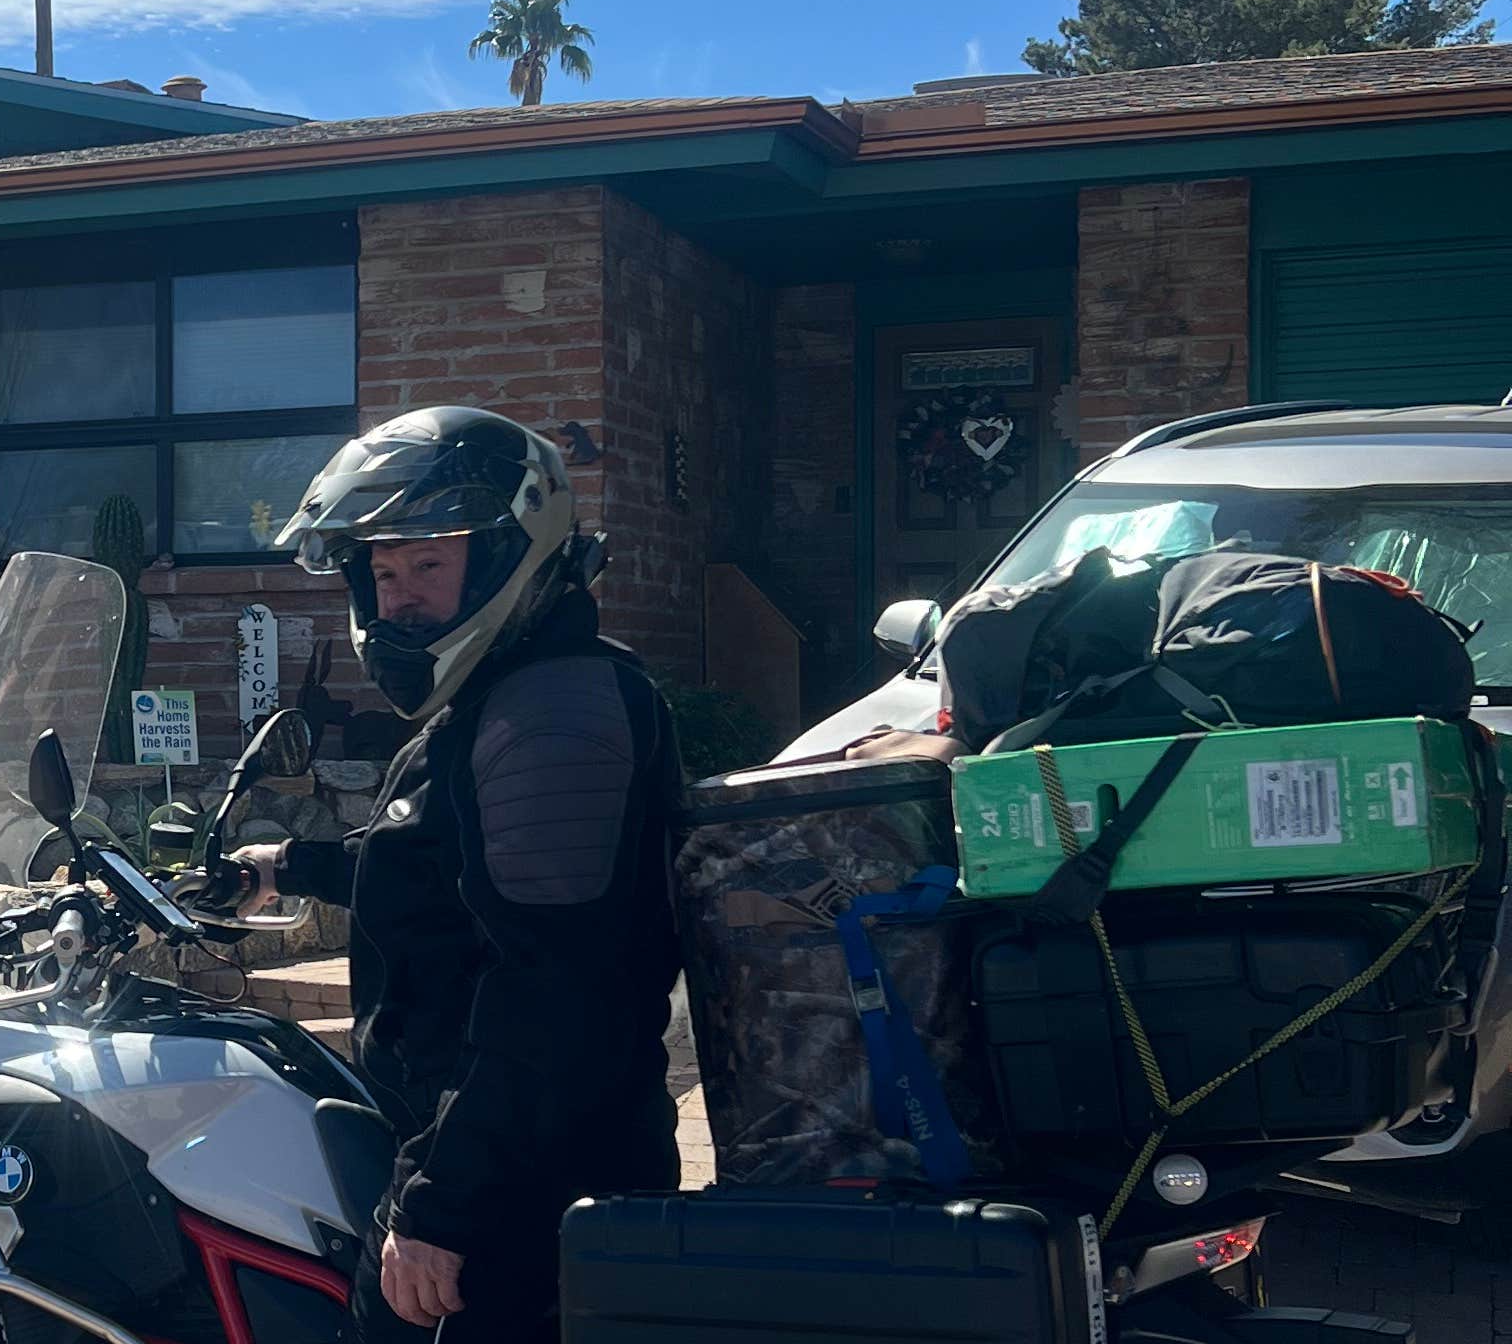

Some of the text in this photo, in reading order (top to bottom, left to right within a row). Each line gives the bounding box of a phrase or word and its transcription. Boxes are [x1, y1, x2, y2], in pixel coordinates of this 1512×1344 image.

[251, 611, 266, 710] WELCOM
[165, 698, 189, 710] This
[157, 710, 190, 722] Home
[139, 723, 191, 735] Harvests
[142, 736, 192, 748] the Rain
